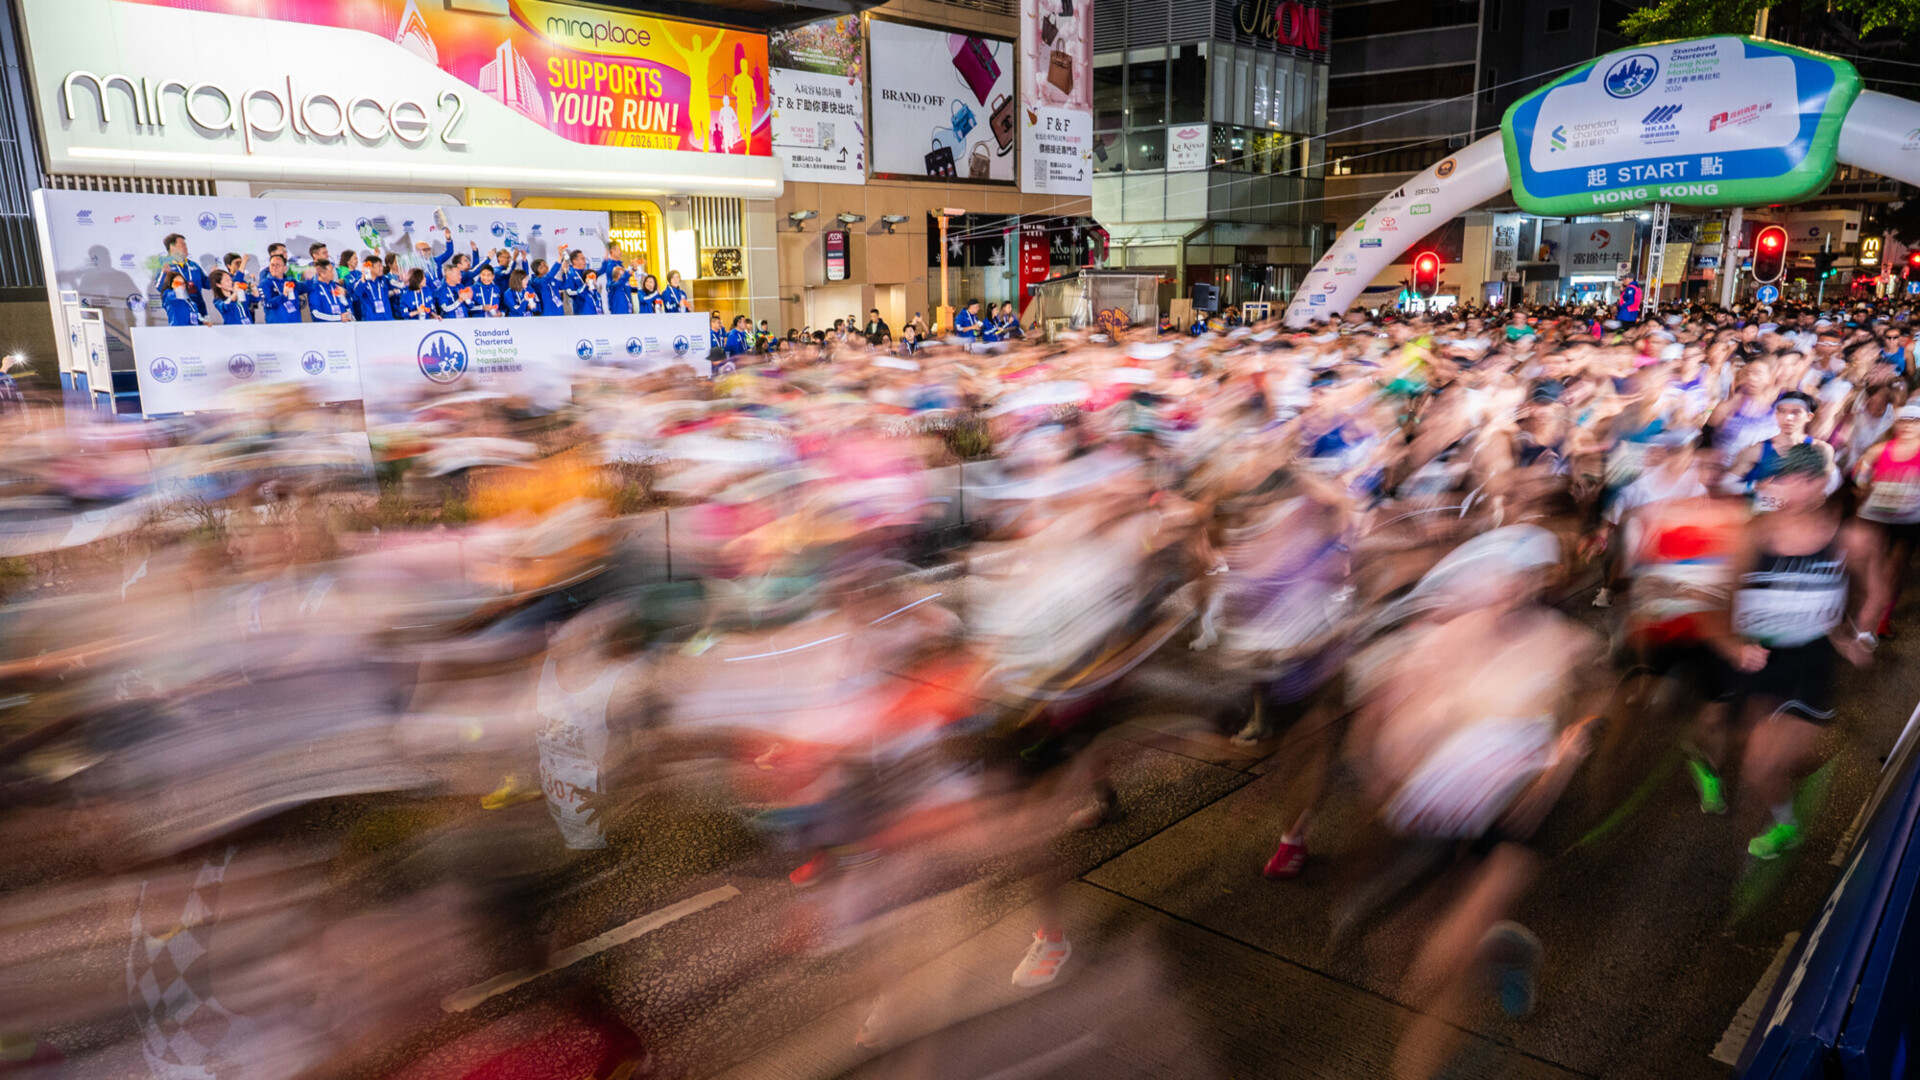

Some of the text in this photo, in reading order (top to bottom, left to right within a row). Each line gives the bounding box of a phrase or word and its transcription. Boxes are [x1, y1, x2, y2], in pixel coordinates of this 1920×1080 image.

[547, 17, 650, 47] miraplace
[1274, 0, 1329, 52] ONE
[1673, 44, 1716, 54] Standard
[1671, 50, 1717, 61] Chartered
[1667, 66, 1713, 76] Marathon
[548, 57, 662, 98] SUPPORTS
[786, 98, 794, 109] &
[882, 89, 945, 106] BRAND OFF
[64, 70, 468, 155] miraplace 2
[549, 91, 680, 133] YOUR RUN!
[1047, 117, 1071, 132] F & F
[1574, 118, 1617, 131] standard
[1645, 124, 1676, 132] HKAAA
[1573, 127, 1619, 139] chartered
[630, 134, 673, 149] 2026.1.18
[1588, 156, 1723, 187] 起 START 點
[1415, 187, 1440, 196] SEIKO
[1592, 184, 1719, 205] HONG KONG
[474, 328, 510, 337] Standard
[475, 337, 513, 346] Chartered
[476, 347, 518, 356] Hong Kong
[477, 356, 515, 364] Marathon
